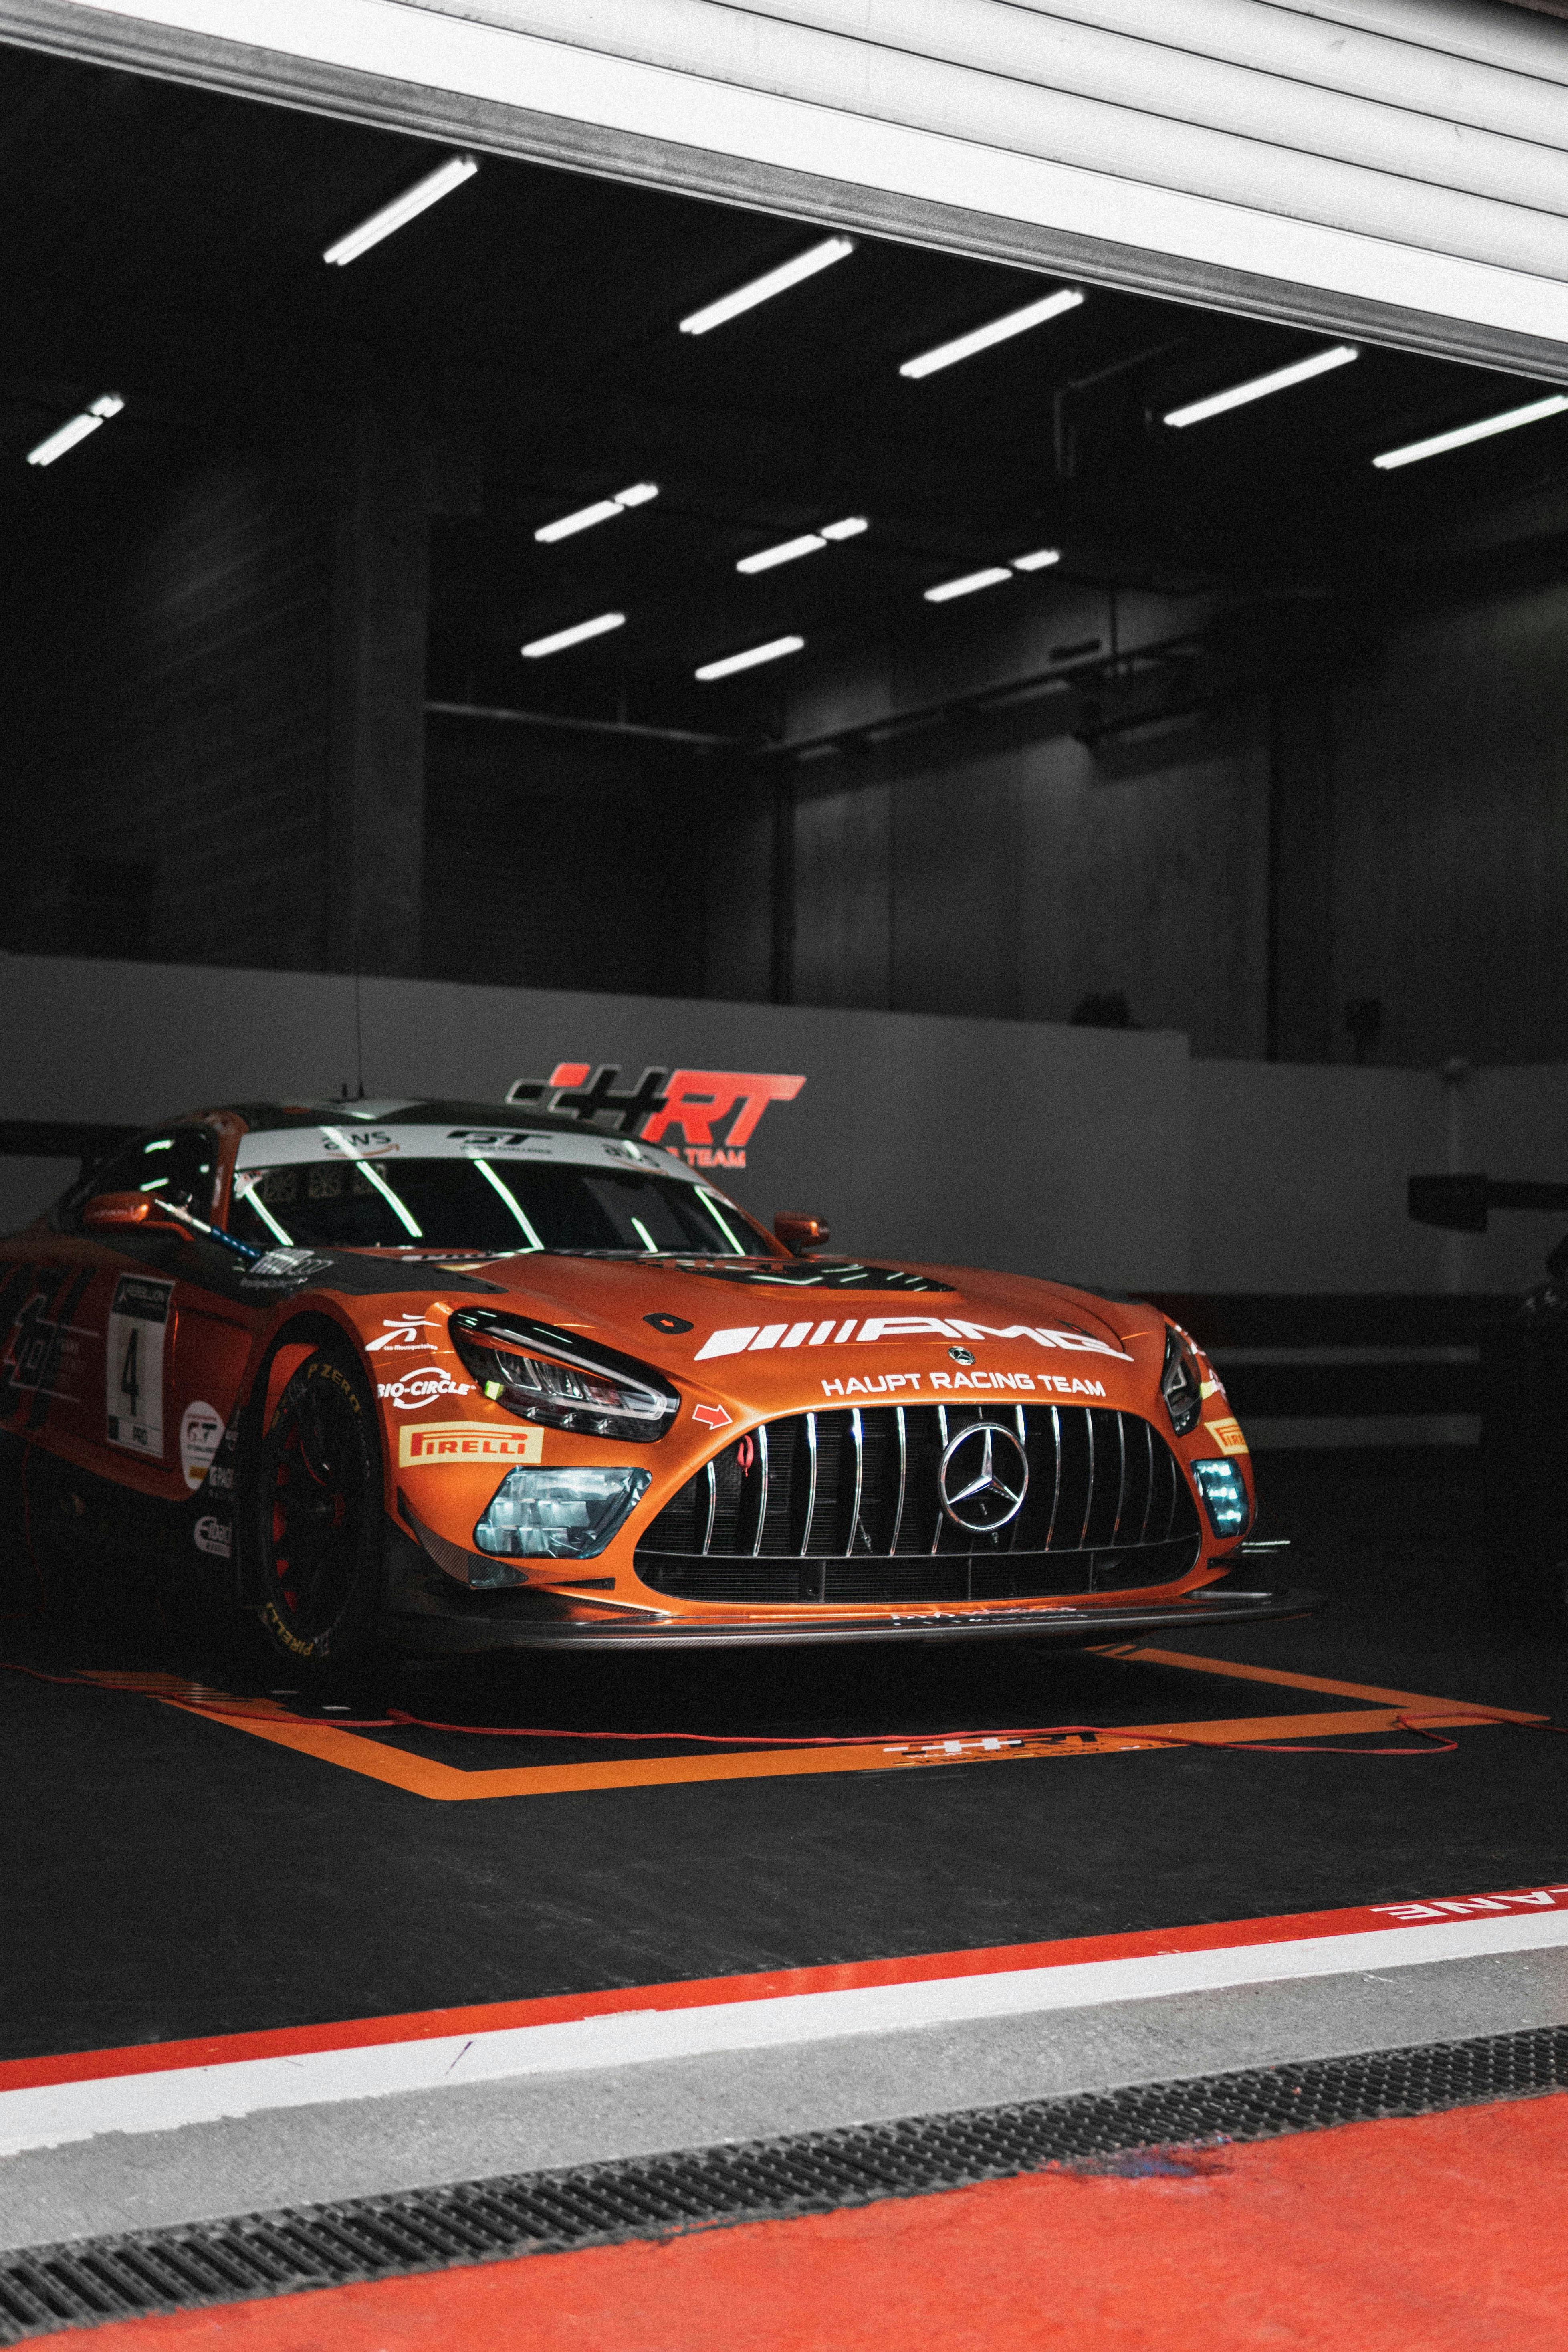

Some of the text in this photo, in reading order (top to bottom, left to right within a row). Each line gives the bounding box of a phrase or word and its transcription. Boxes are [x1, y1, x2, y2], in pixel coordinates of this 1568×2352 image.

[547, 1062, 807, 1147] HRT
[684, 1147, 747, 1168] TEAM
[857, 1316, 1134, 1361] AMG
[121, 1327, 139, 1416] 4
[320, 1363, 361, 1413] ZERO
[821, 1372, 1106, 1397] HAUPT RACING TEAM
[410, 1429, 528, 1456] PIRELLI
[266, 1601, 315, 1657] PIRELLI
